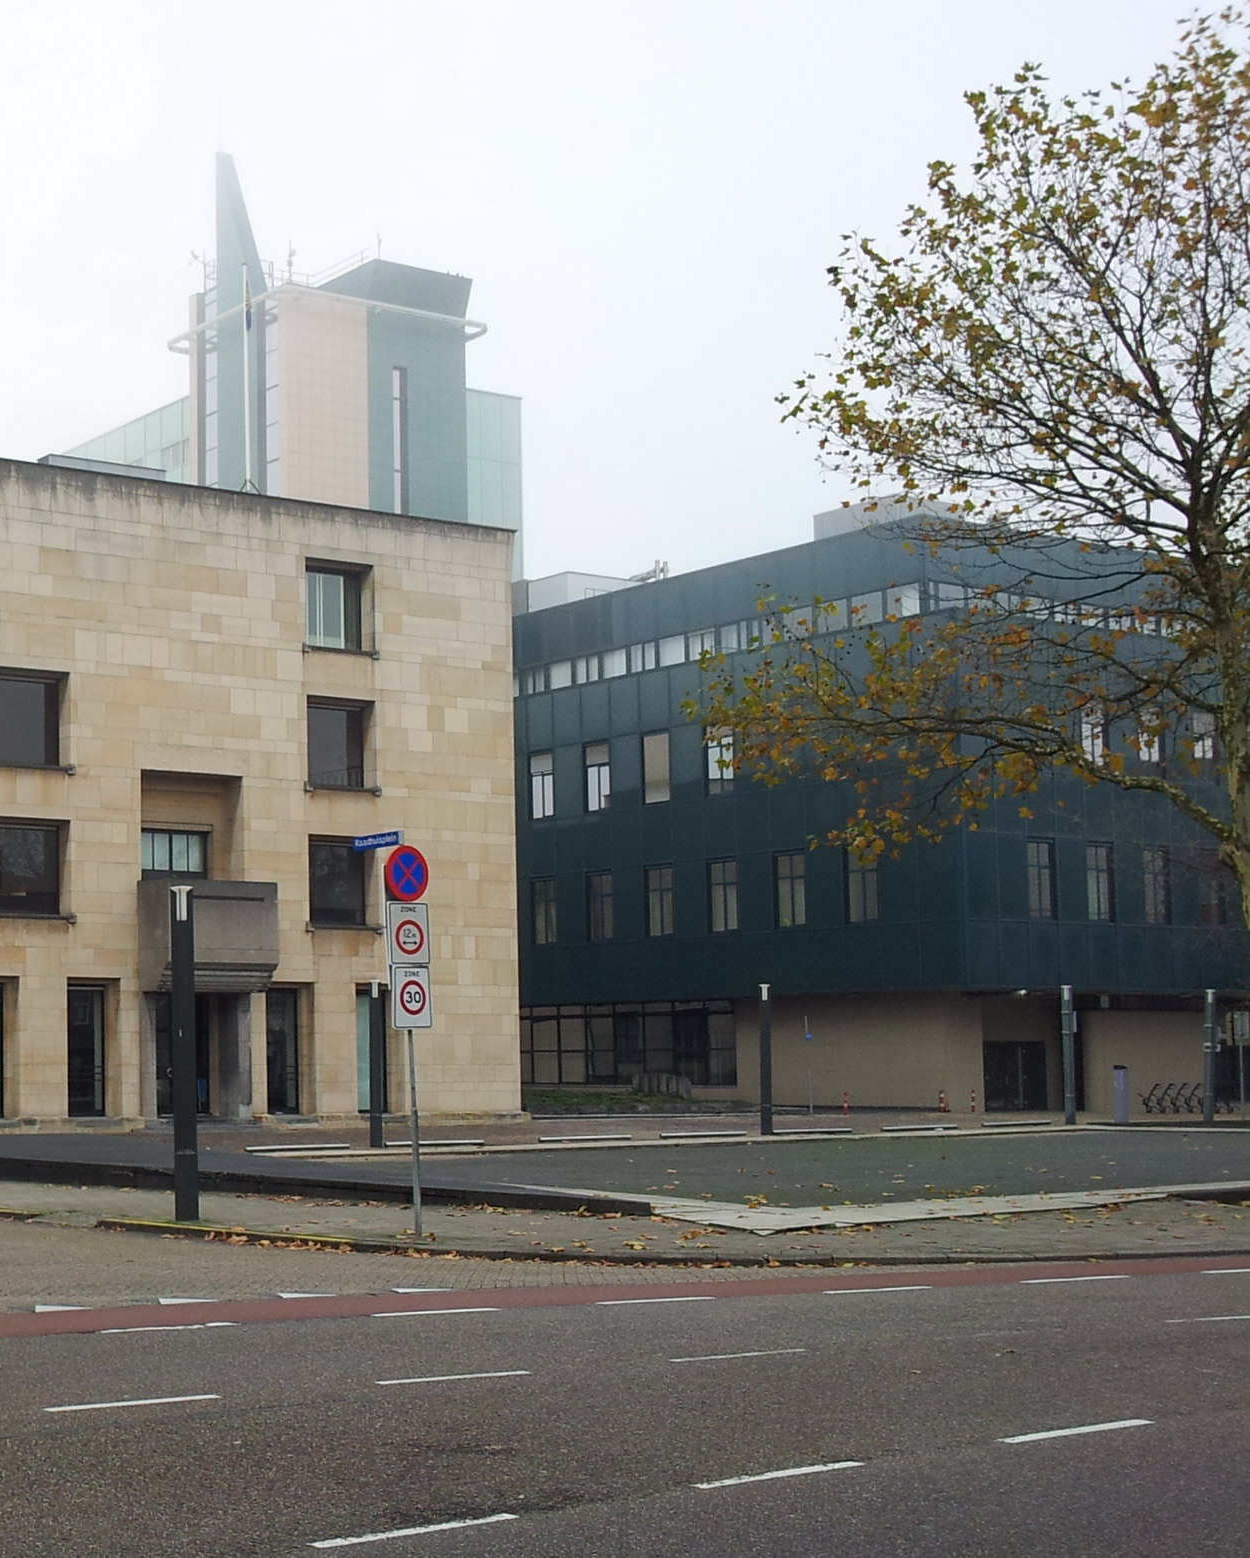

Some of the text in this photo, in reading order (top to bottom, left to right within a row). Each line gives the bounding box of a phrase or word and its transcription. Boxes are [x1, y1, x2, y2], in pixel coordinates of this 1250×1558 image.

[354, 833, 397, 847] Raadhuisplein
[400, 905, 417, 913] ZONE
[403, 970, 421, 978] ZONE
[405, 991, 422, 1004] 30
